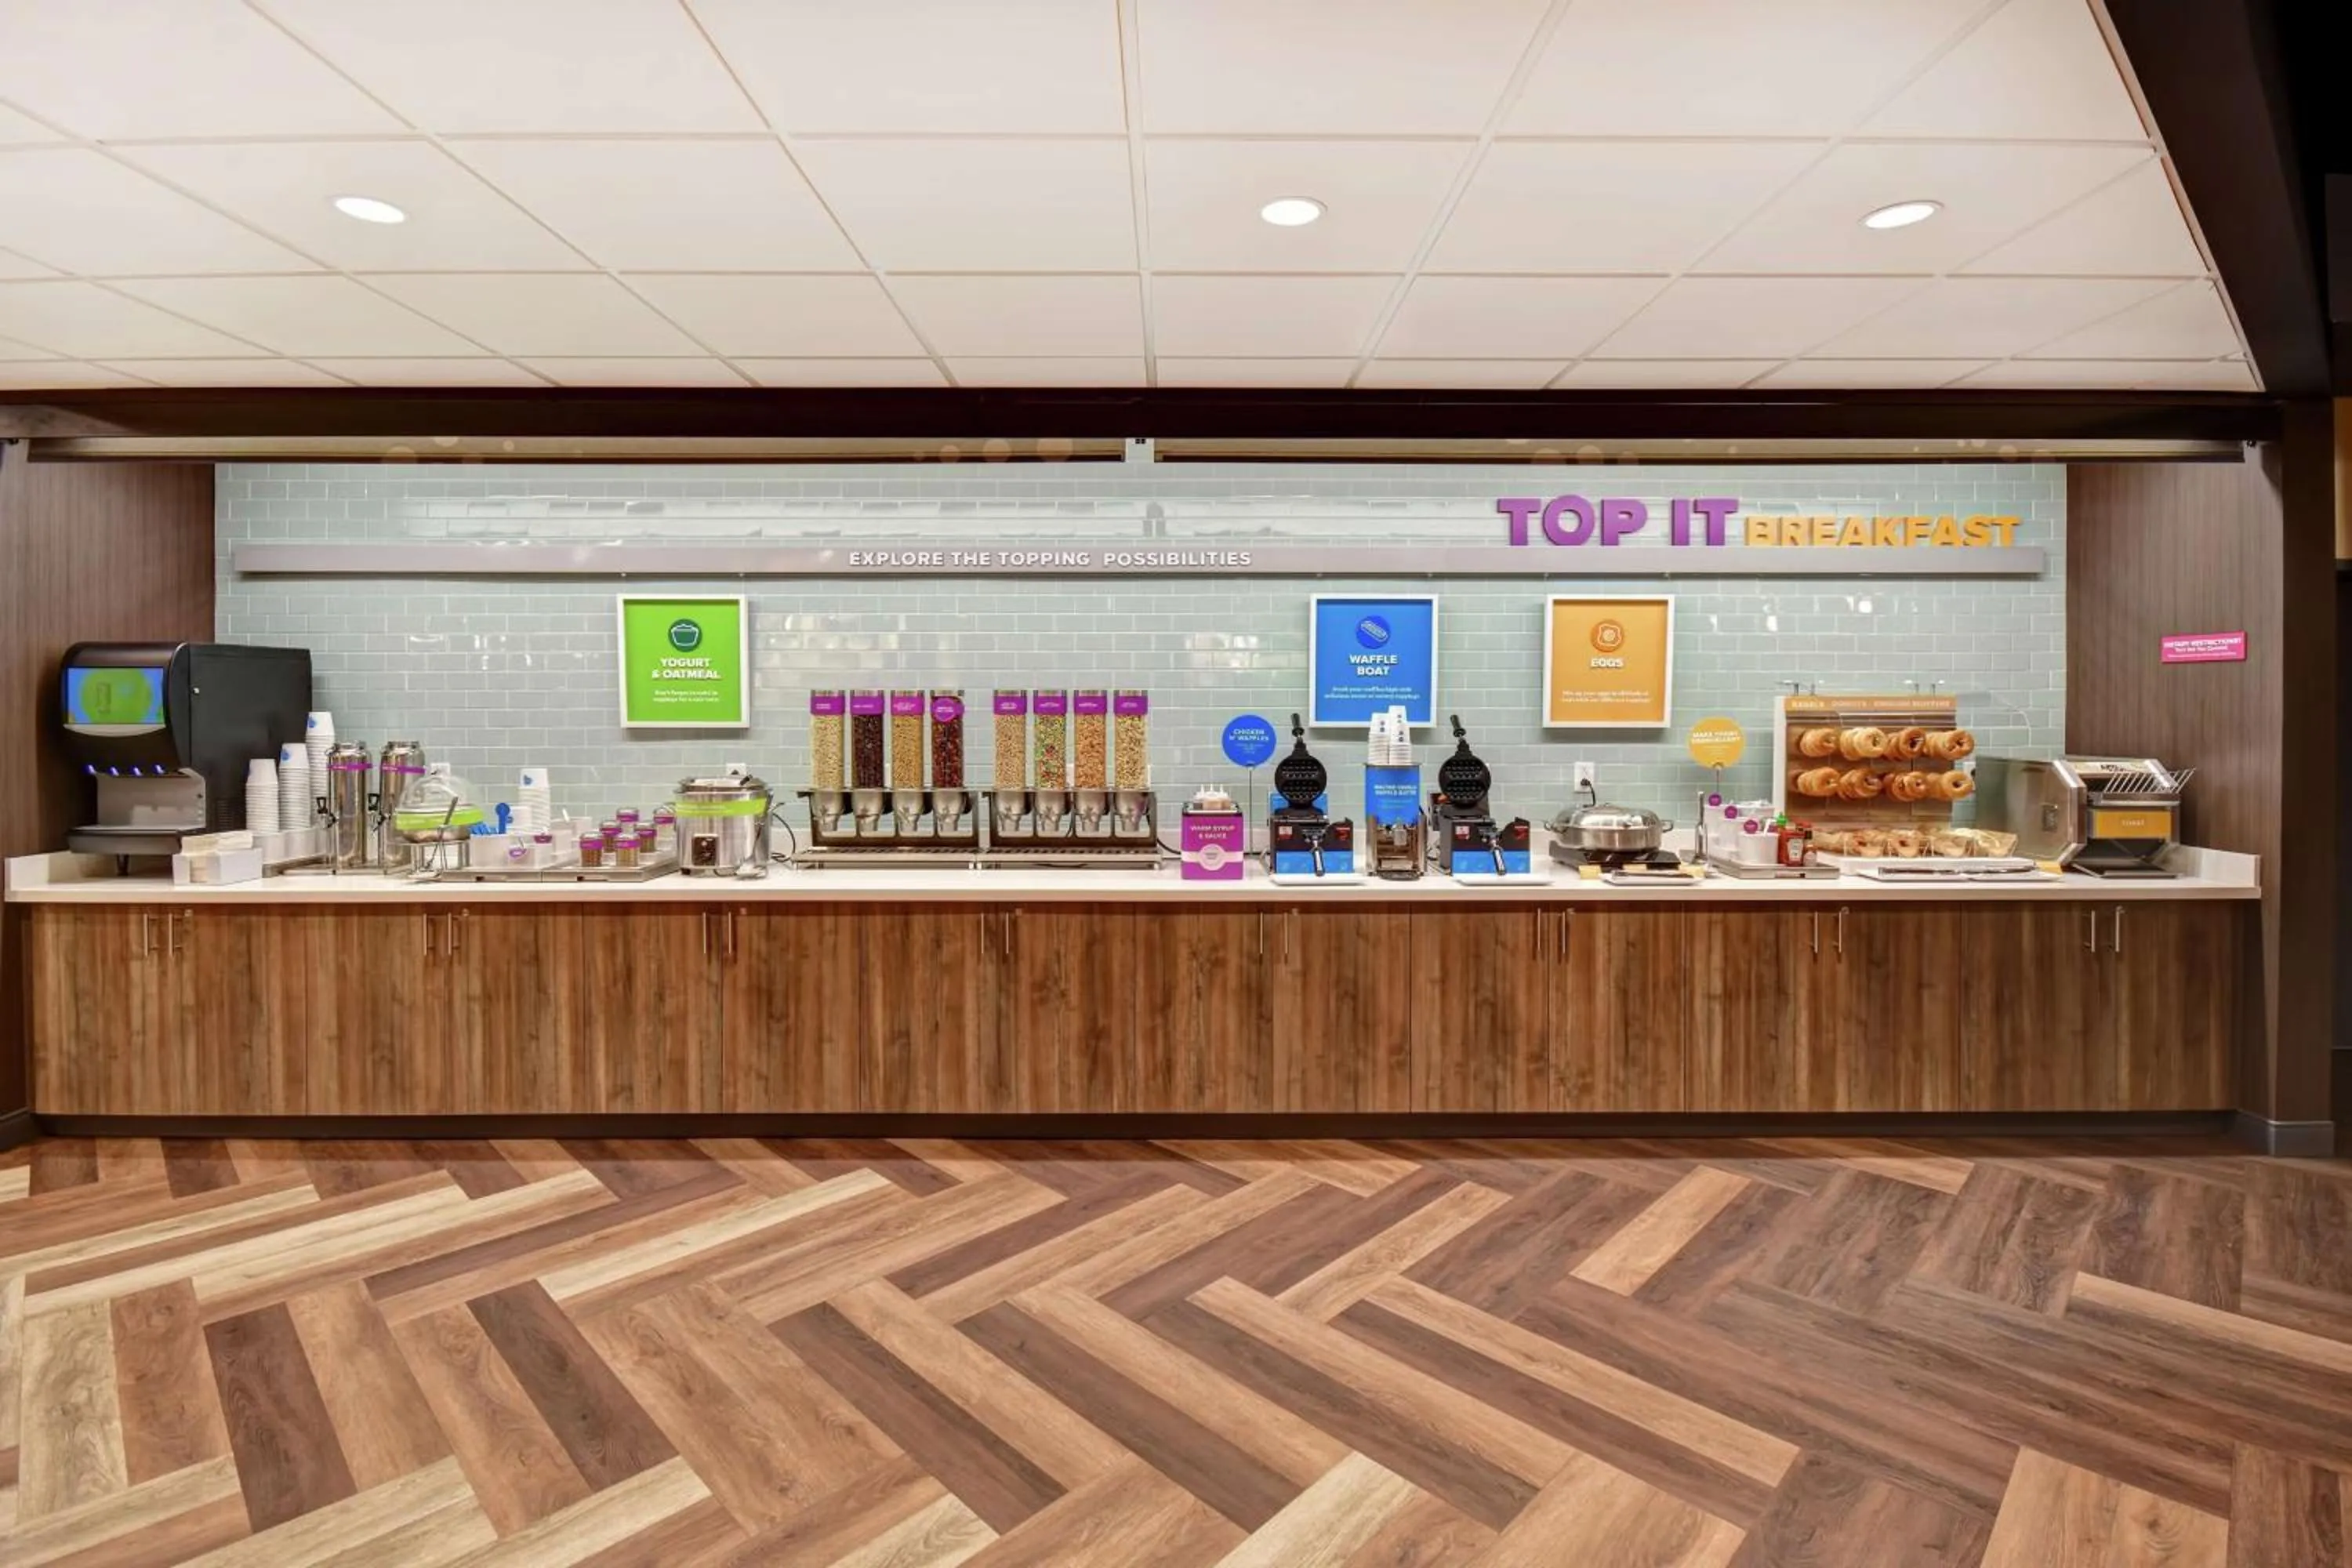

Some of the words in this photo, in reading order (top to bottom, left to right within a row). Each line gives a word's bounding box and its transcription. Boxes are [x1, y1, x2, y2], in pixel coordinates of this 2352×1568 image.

[1497, 494, 1648, 546] TOP
[1671, 498, 1739, 546] IT
[1744, 515, 2024, 547] BREAKFAST
[849, 551, 943, 567] EXPLORE
[951, 551, 991, 567] THE
[997, 551, 1091, 567] TOPPING
[1103, 551, 1252, 567] POSSIBILITIES
[660, 658, 711, 667] YOGURT
[1349, 654, 1399, 664] WAFFLE
[1590, 658, 1624, 667] EGGS
[652, 670, 659, 678] &
[662, 669, 722, 679] OATMEAL
[1356, 666, 1390, 676] BOAT
